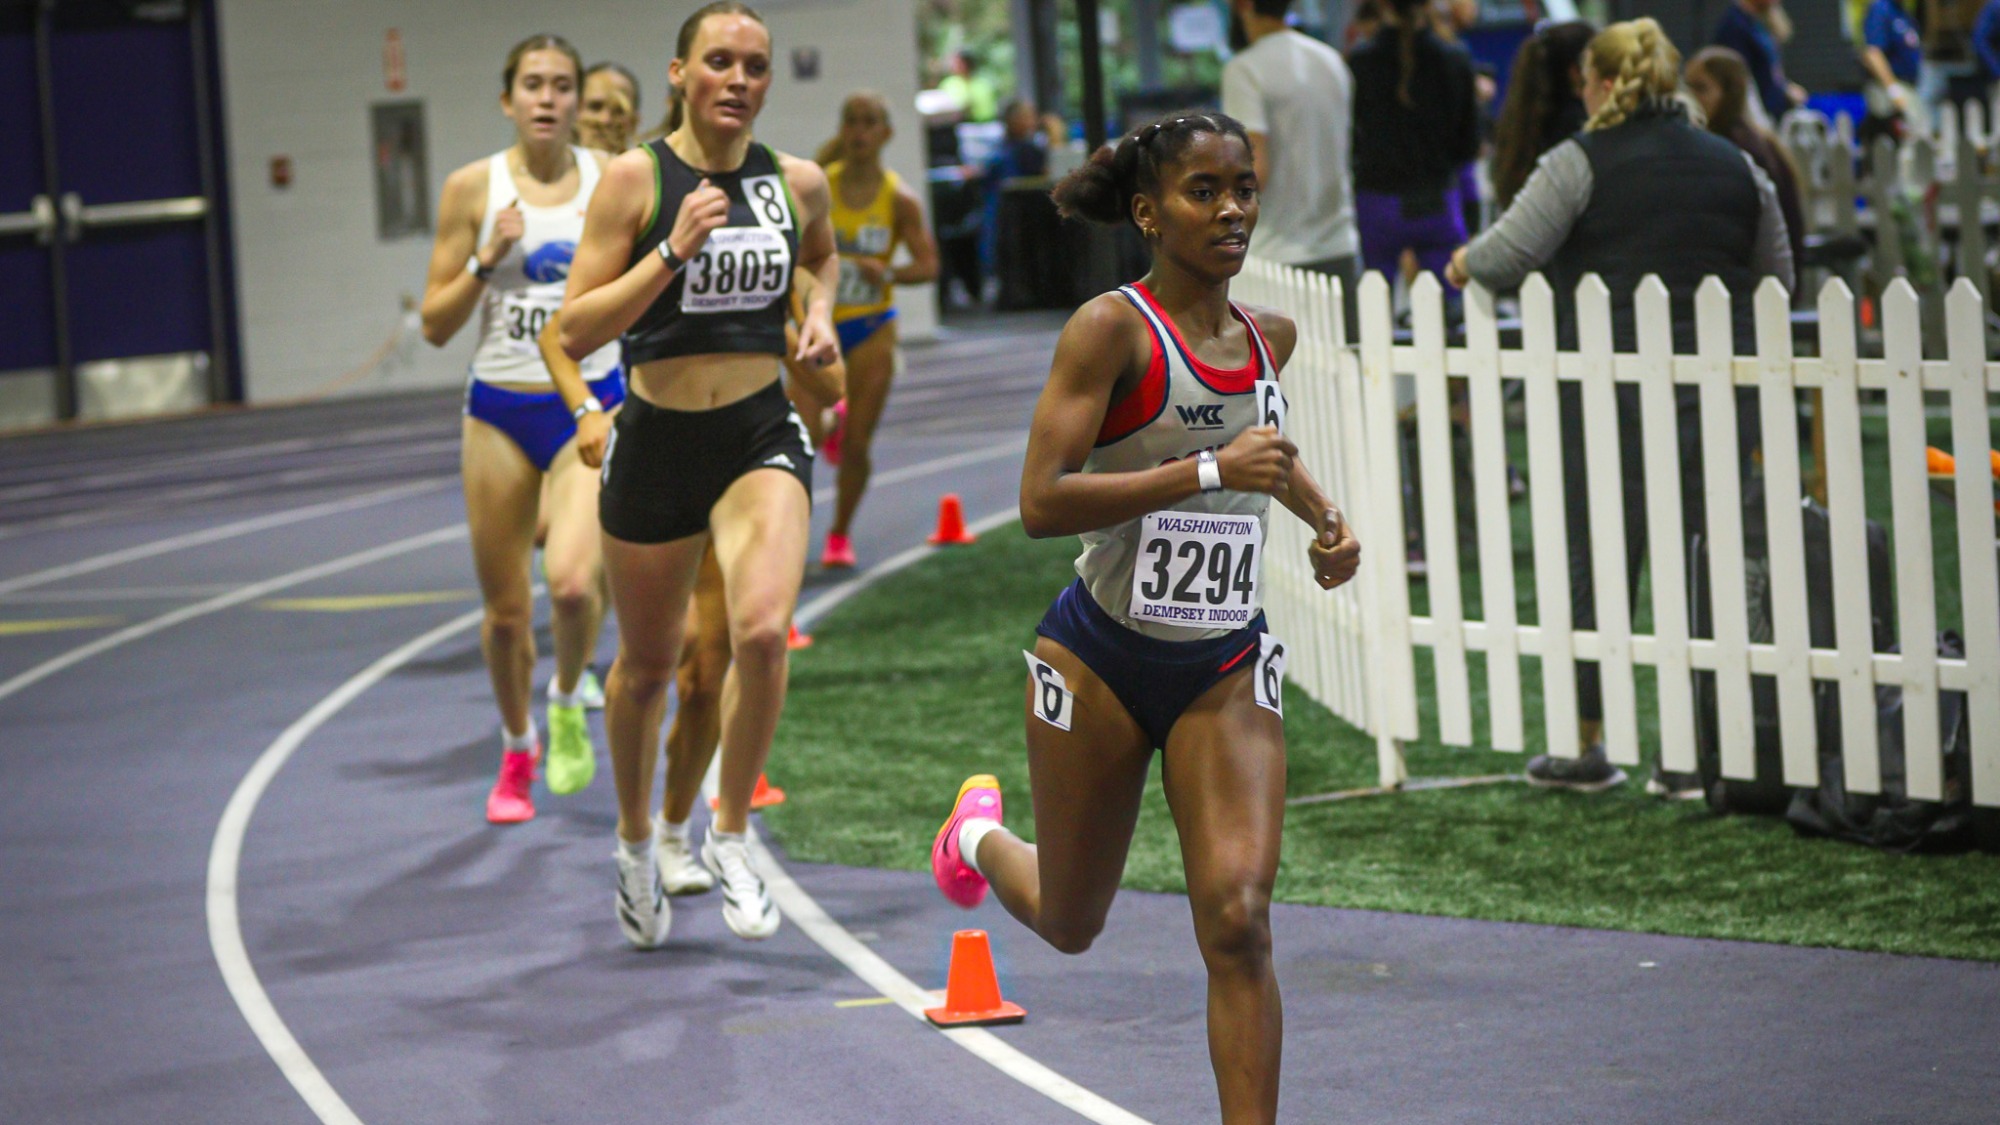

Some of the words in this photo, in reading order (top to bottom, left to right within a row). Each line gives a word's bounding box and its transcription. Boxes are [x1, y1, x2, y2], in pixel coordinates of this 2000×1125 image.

[753, 180, 785, 225] 8
[708, 231, 773, 244] ASHINGTON
[690, 249, 784, 295] 3805
[508, 305, 560, 342] 30
[1157, 517, 1253, 535] WASHINGTON
[1141, 538, 1255, 605] 3294
[1143, 604, 1206, 621] DEMPSEY
[1208, 608, 1249, 622] INDOOR
[1035, 663, 1063, 722] 6
[1262, 643, 1284, 709] 6
